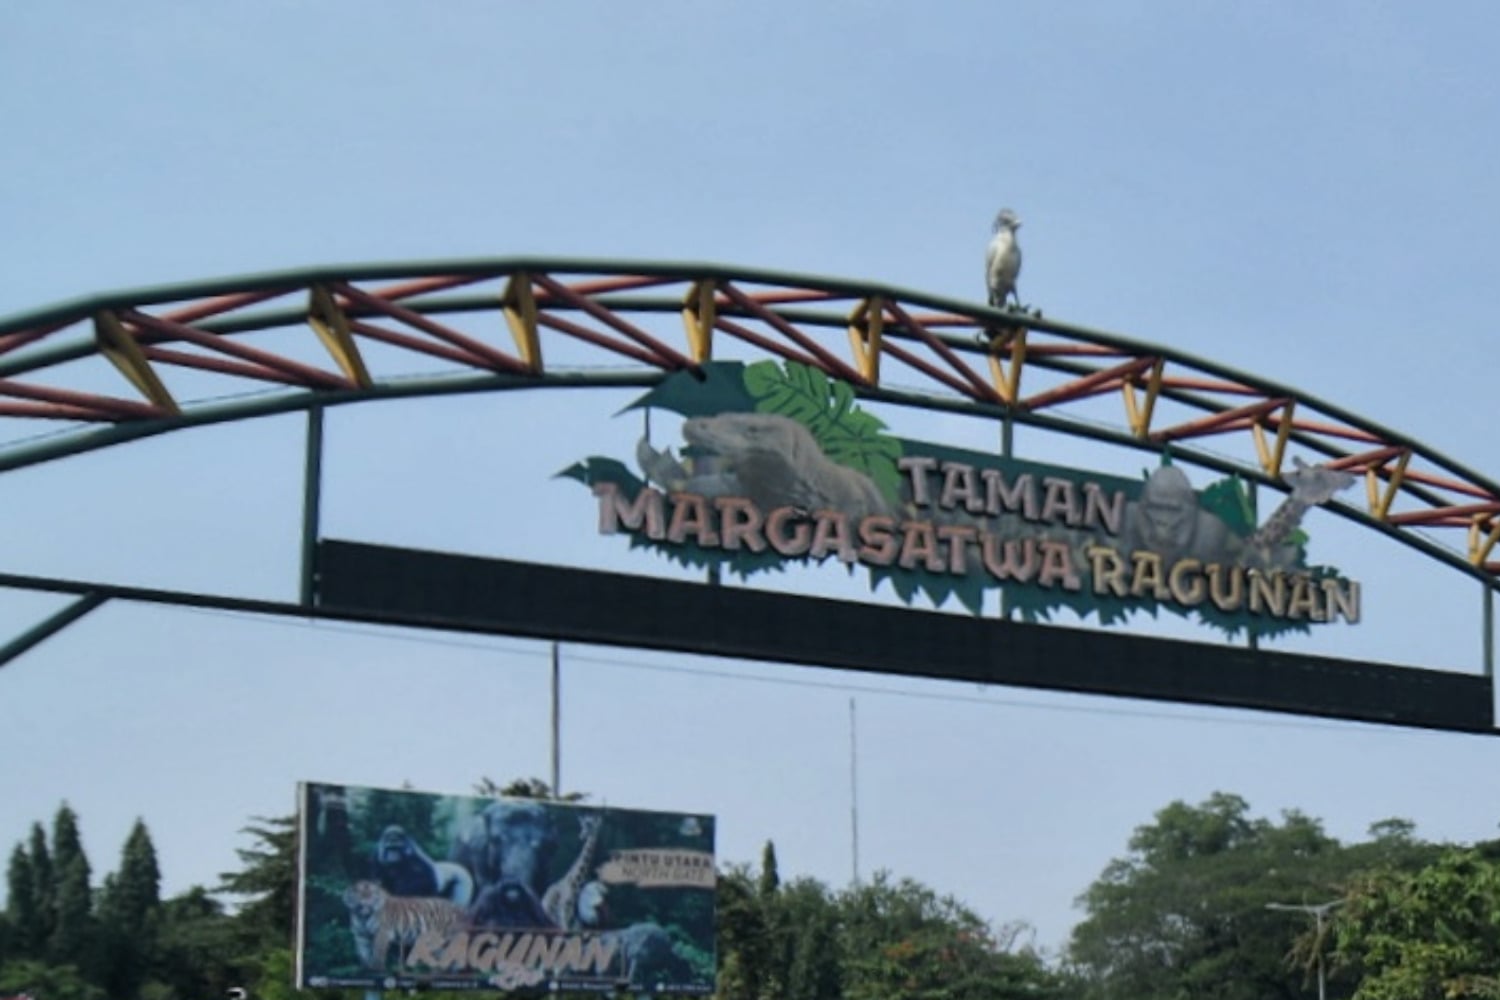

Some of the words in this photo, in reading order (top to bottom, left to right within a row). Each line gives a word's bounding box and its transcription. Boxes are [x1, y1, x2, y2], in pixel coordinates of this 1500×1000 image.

[899, 457, 1125, 534] TAMAN
[594, 483, 1082, 588] MARGASATWA
[1088, 546, 1361, 622] RAGUNAN
[663, 854, 711, 868] UTARA
[407, 932, 618, 973] RAGUNAN
